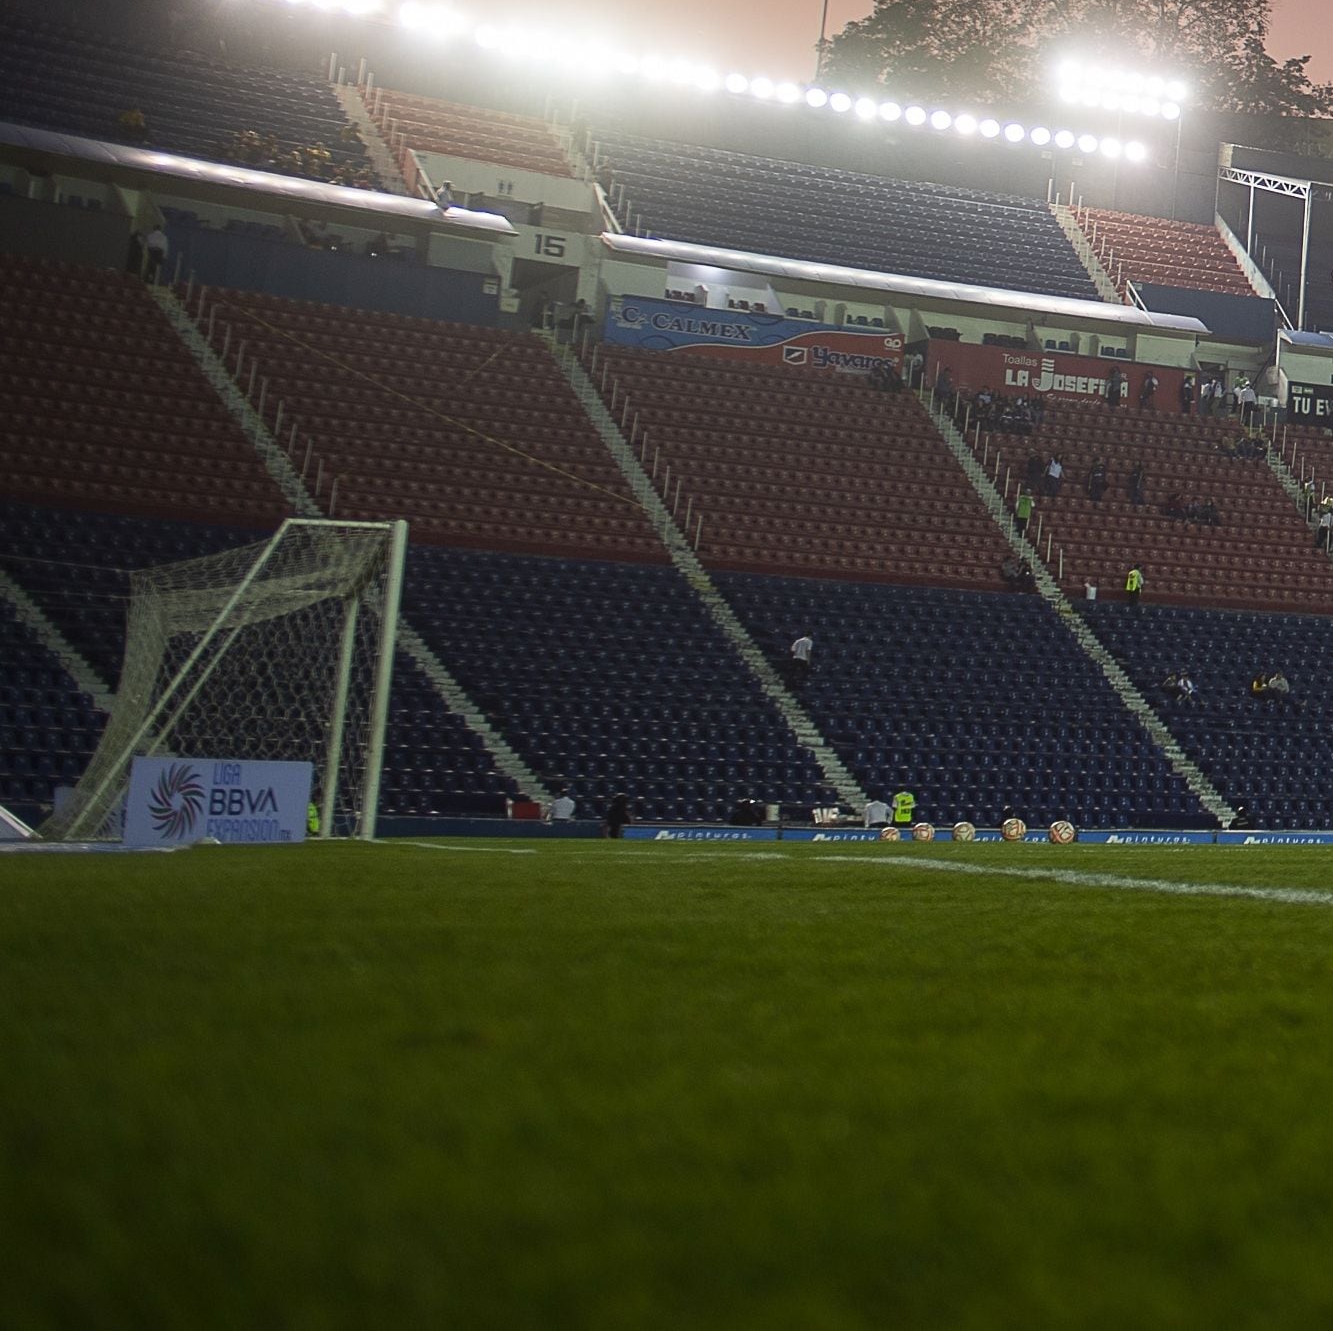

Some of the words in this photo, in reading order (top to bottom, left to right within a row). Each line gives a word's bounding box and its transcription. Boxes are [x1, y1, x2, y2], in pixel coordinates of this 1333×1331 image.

[534, 234, 566, 258] 15
[651, 313, 751, 341] CALMEX
[1002, 353, 1038, 367] Toallas
[1005, 369, 1029, 387] LA
[1293, 396, 1311, 414] TU
[213, 763, 241, 785] LIGA
[209, 786, 278, 815] BBVA
